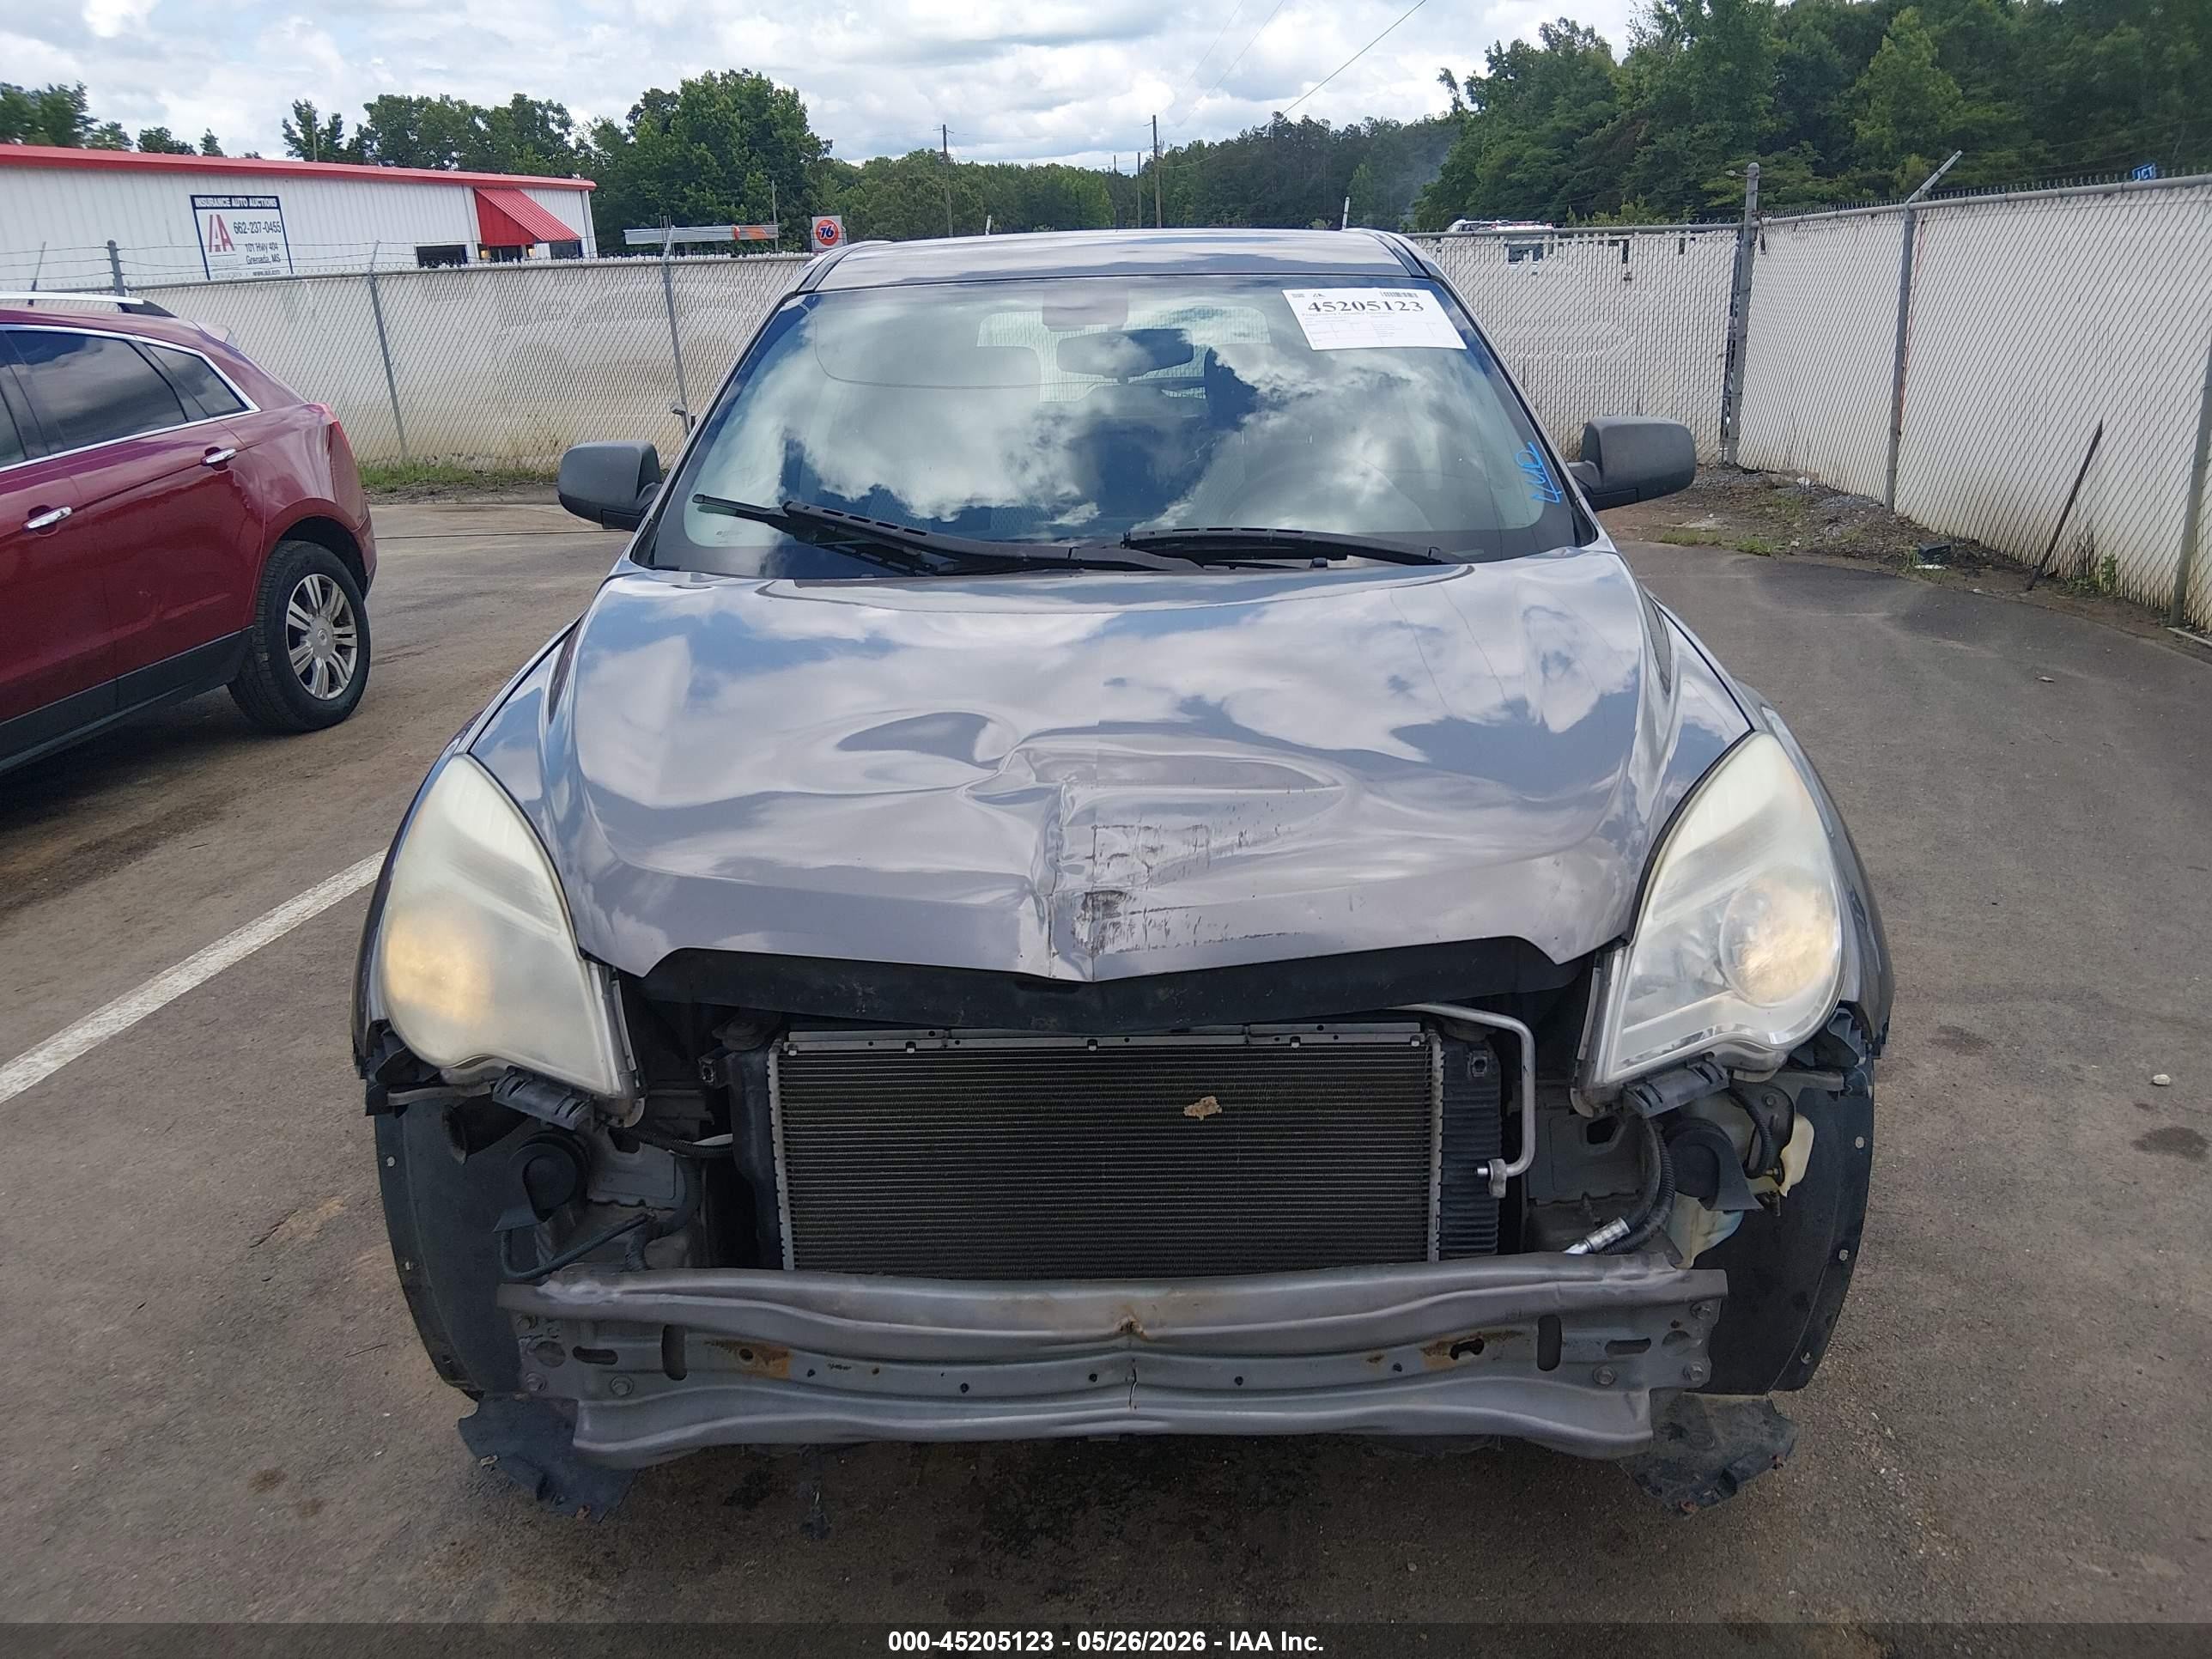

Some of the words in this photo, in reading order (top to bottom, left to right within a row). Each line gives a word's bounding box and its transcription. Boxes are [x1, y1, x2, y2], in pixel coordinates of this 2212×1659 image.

[195, 198, 231, 207] INSURANCE
[232, 198, 248, 207] AUTO
[249, 198, 277, 207] AUCTIONS
[234, 222, 281, 234] 662-237-0455
[819, 224, 835, 239] 76
[245, 243, 256, 252] 101
[256, 242, 268, 253] Hwy
[269, 242, 278, 251] 404
[271, 253, 281, 263] MS
[1308, 301, 1424, 312] 45205123
